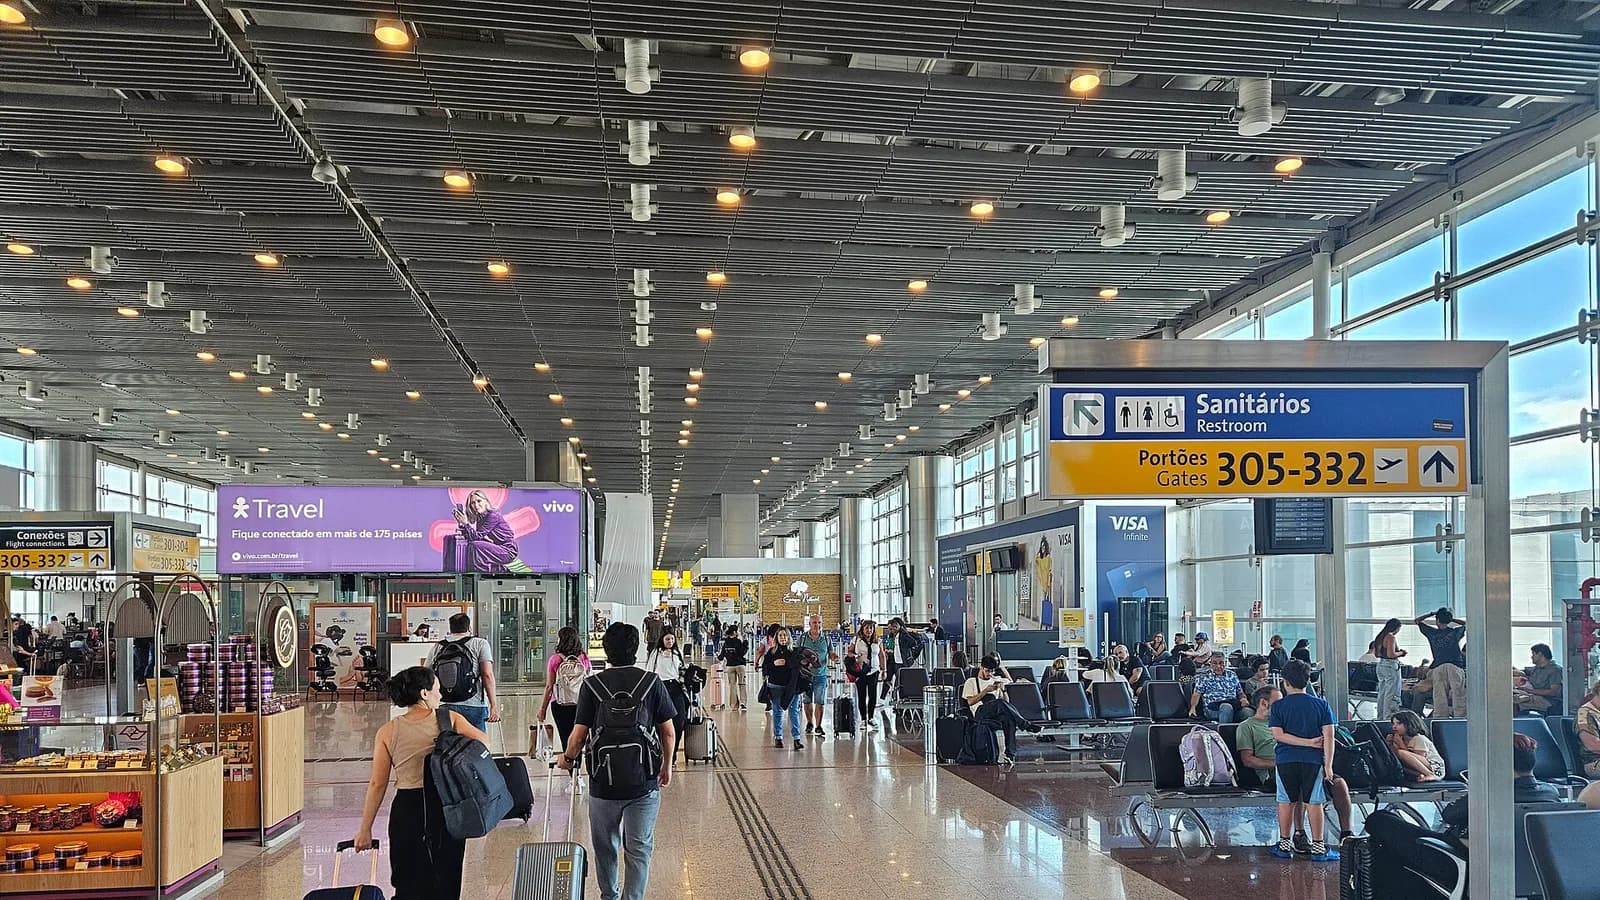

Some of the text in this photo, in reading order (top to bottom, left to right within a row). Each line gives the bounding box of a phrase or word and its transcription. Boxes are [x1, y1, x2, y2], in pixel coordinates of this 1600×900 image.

[1196, 392, 1311, 415] Sanitários
[1197, 419, 1268, 433] Restroom
[1139, 448, 1208, 467] Portões
[1217, 451, 1367, 486] 305-332
[1157, 470, 1208, 487] Gates
[252, 497, 324, 519] Travel
[542, 499, 575, 514] vivo
[1108, 515, 1149, 531] VISA
[17, 530, 65, 540] Conexões
[231, 528, 423, 542] Fique conectado em mais de 175 países
[1058, 533, 1072, 546] VISA
[1123, 532, 1149, 541] Infinite
[6, 540, 66, 548] Flight connections
[0, 554, 66, 568] 305-332
[242, 552, 299, 560] vivo.com.br/travel
[33, 575, 101, 592] STARBUCKS
